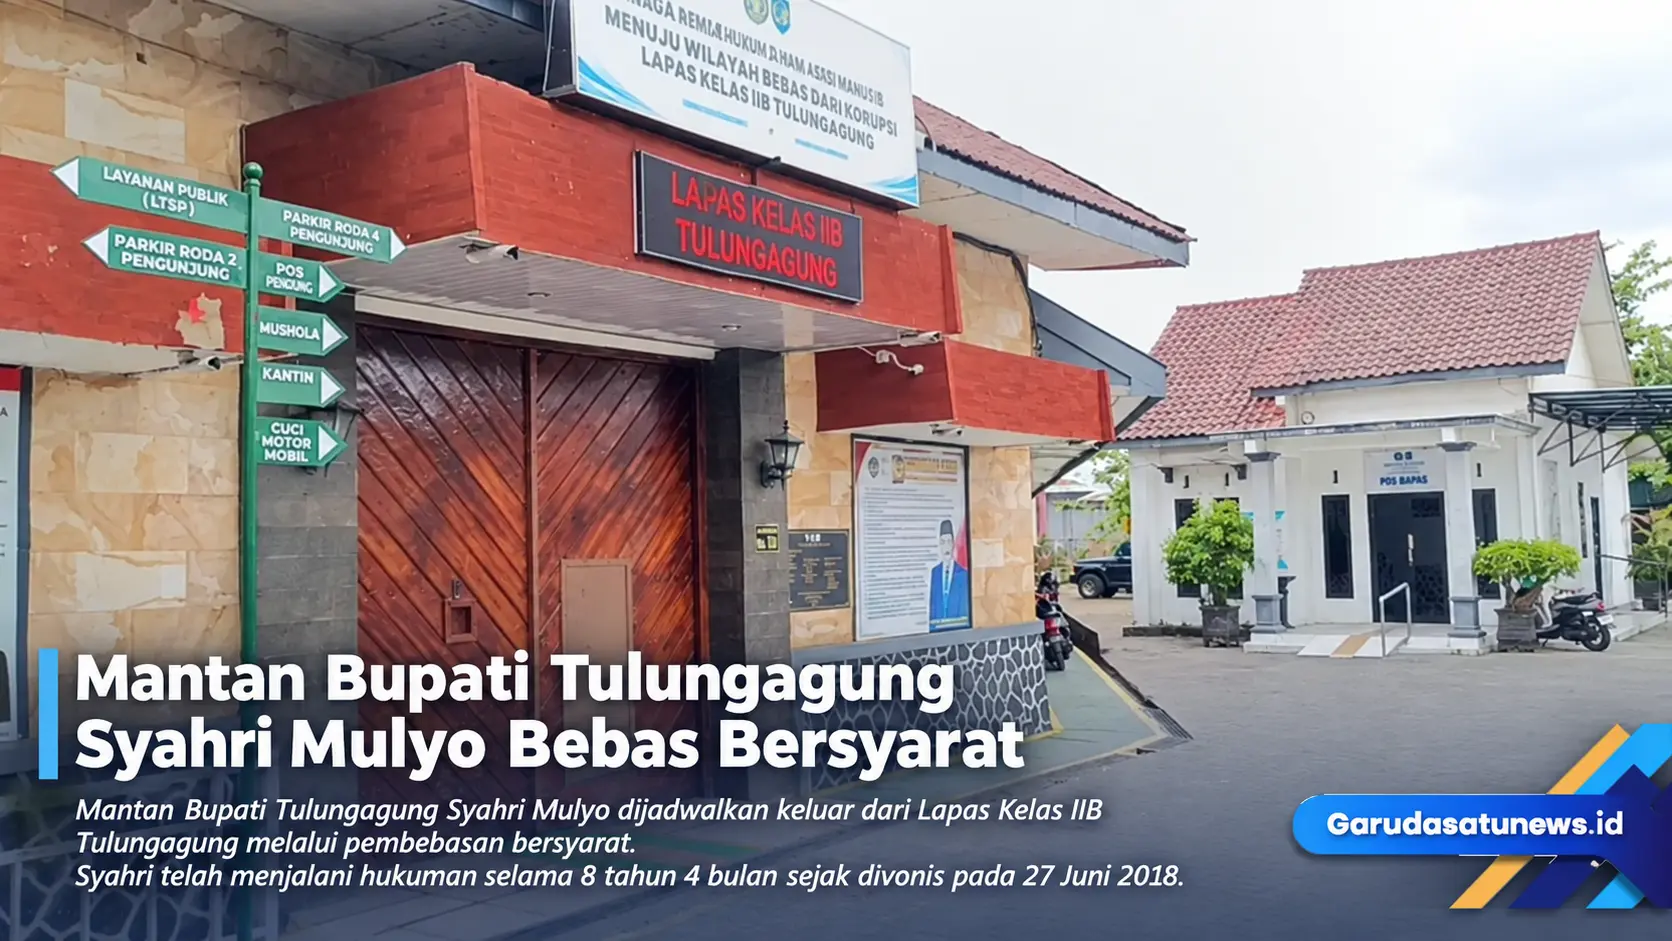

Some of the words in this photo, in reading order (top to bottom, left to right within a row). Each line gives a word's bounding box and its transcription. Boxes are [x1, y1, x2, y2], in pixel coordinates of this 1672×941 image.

[724, 26, 767, 59] HUKUM
[779, 49, 806, 75] HAM
[605, 5, 680, 52] MENUJU
[684, 36, 760, 83] WILAYAH
[762, 68, 809, 102] BEBAS
[811, 87, 842, 116] DARI
[845, 102, 898, 137] KORUPSI
[641, 45, 697, 84] LAPAS
[699, 69, 749, 103] KELAS
[751, 89, 771, 112] IIB
[773, 97, 875, 150] TULUNGAGUNG
[103, 165, 174, 195] LAYANAN
[177, 183, 229, 207] PUBLIK
[142, 191, 196, 217] (LTSP)
[671, 171, 747, 223] LAPAS
[752, 195, 816, 241] KELAS
[820, 215, 844, 248] IIB
[283, 209, 331, 230] PARKIR
[334, 220, 370, 239] RODA
[370, 229, 380, 242] 4
[114, 234, 175, 257] PARKIR
[178, 245, 217, 265] RODA
[290, 226, 374, 254] PENGUNJUNG
[675, 217, 837, 288] TULUNGAGUNG
[121, 252, 230, 281] PENGUNJUNG
[276, 262, 305, 279] POS
[259, 321, 320, 341] MUSHOLA
[262, 367, 314, 385] KANTIN
[261, 435, 312, 450] MOTOR
[270, 422, 304, 436] CUCI
[264, 449, 309, 463] MOBIL
[1379, 476, 1397, 486] POS
[1399, 475, 1428, 485] BAPAS
